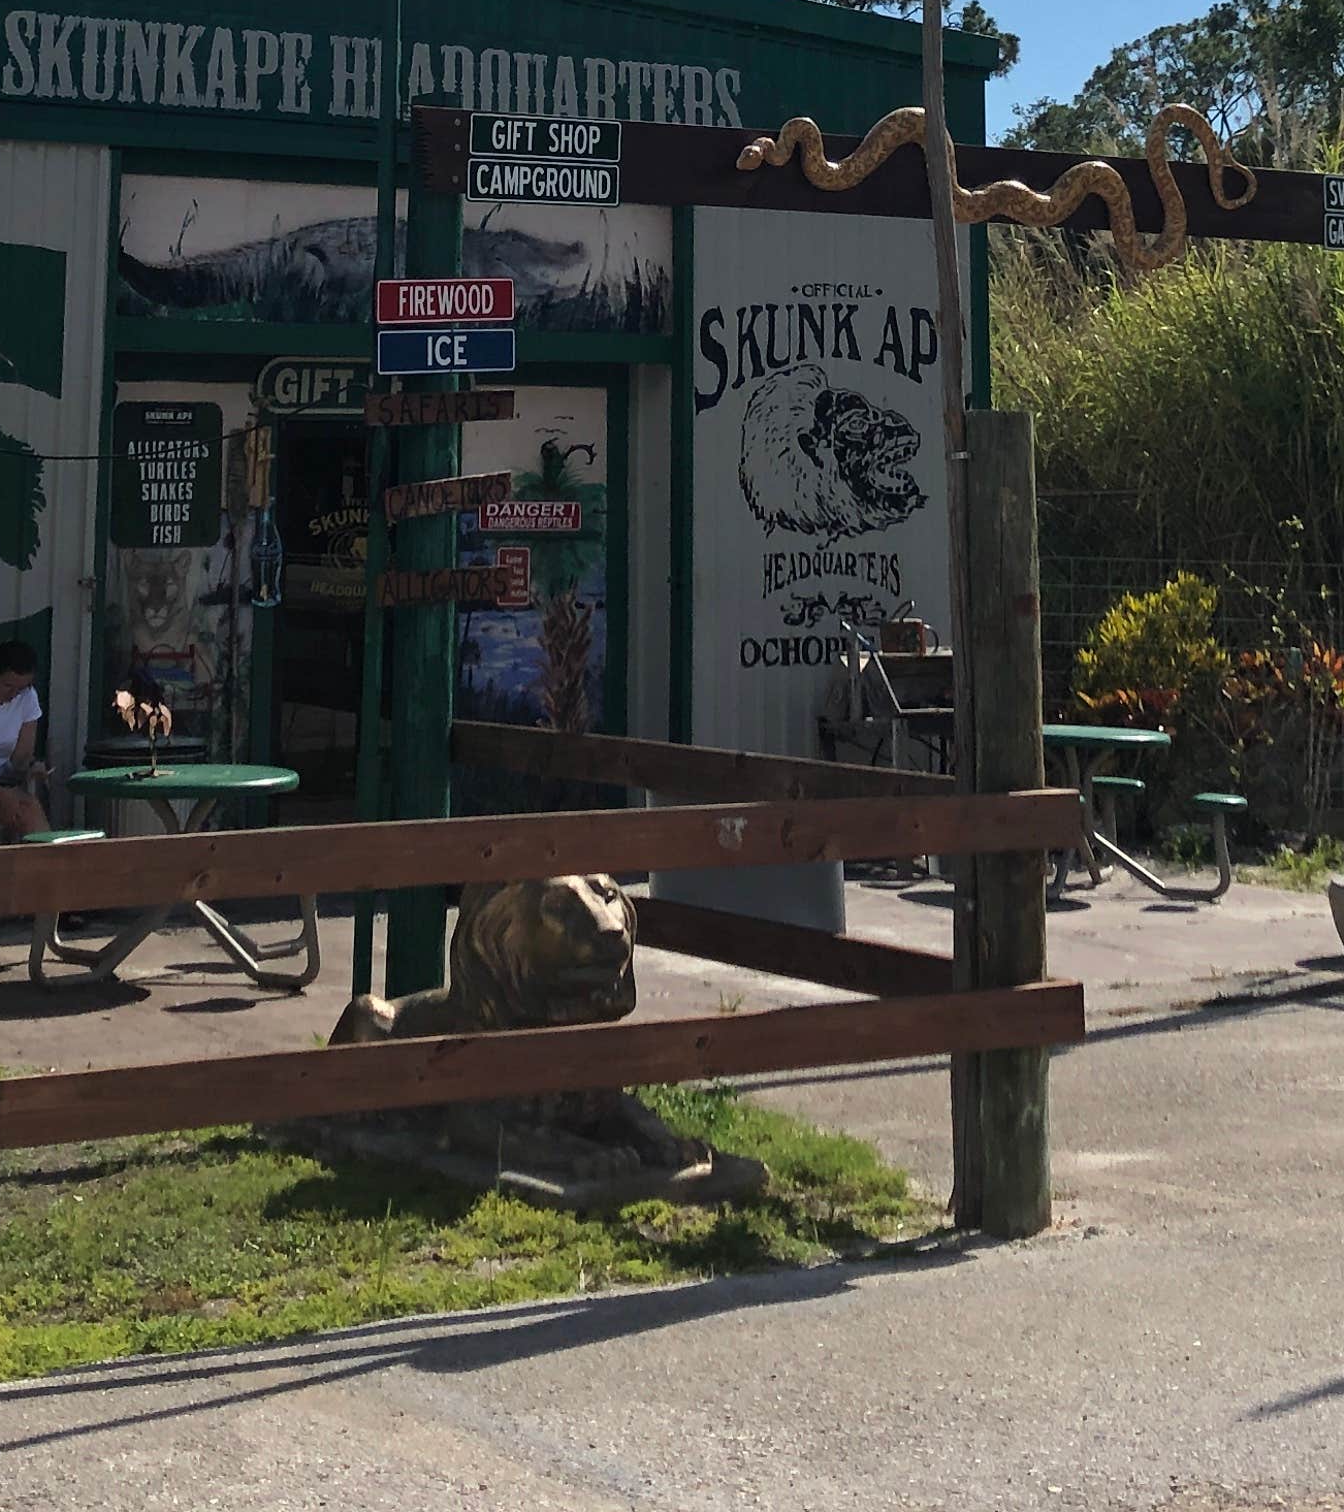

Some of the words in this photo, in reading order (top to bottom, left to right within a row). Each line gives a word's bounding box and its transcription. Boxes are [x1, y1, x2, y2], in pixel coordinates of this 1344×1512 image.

[0, 9, 313, 115] SKUNKAPE
[491, 119, 537, 152] GIFT
[548, 122, 601, 155] SHOP
[476, 163, 612, 200] CAMPGROUND
[398, 283, 494, 317] FIREWOOD
[801, 283, 873, 298] OFFICIAL
[426, 335, 468, 367] ICE
[695, 303, 863, 416] SKUNK
[873, 305, 939, 385] AP
[274, 367, 355, 405] GIFT
[378, 392, 500, 425] SAFARIS
[127, 440, 210, 460] ALLIGATORS
[139, 461, 197, 481] TURTLES
[141, 482, 193, 502] SNAKES
[150, 503, 191, 523] BIRDS
[486, 503, 565, 517] DANGER
[487, 517, 536, 529] DANGEROUS
[537, 517, 573, 529] REPTILES
[152, 525, 182, 544] FISH
[762, 551, 902, 600] HEADQUARTERS
[739, 634, 875, 668] OCHOP
